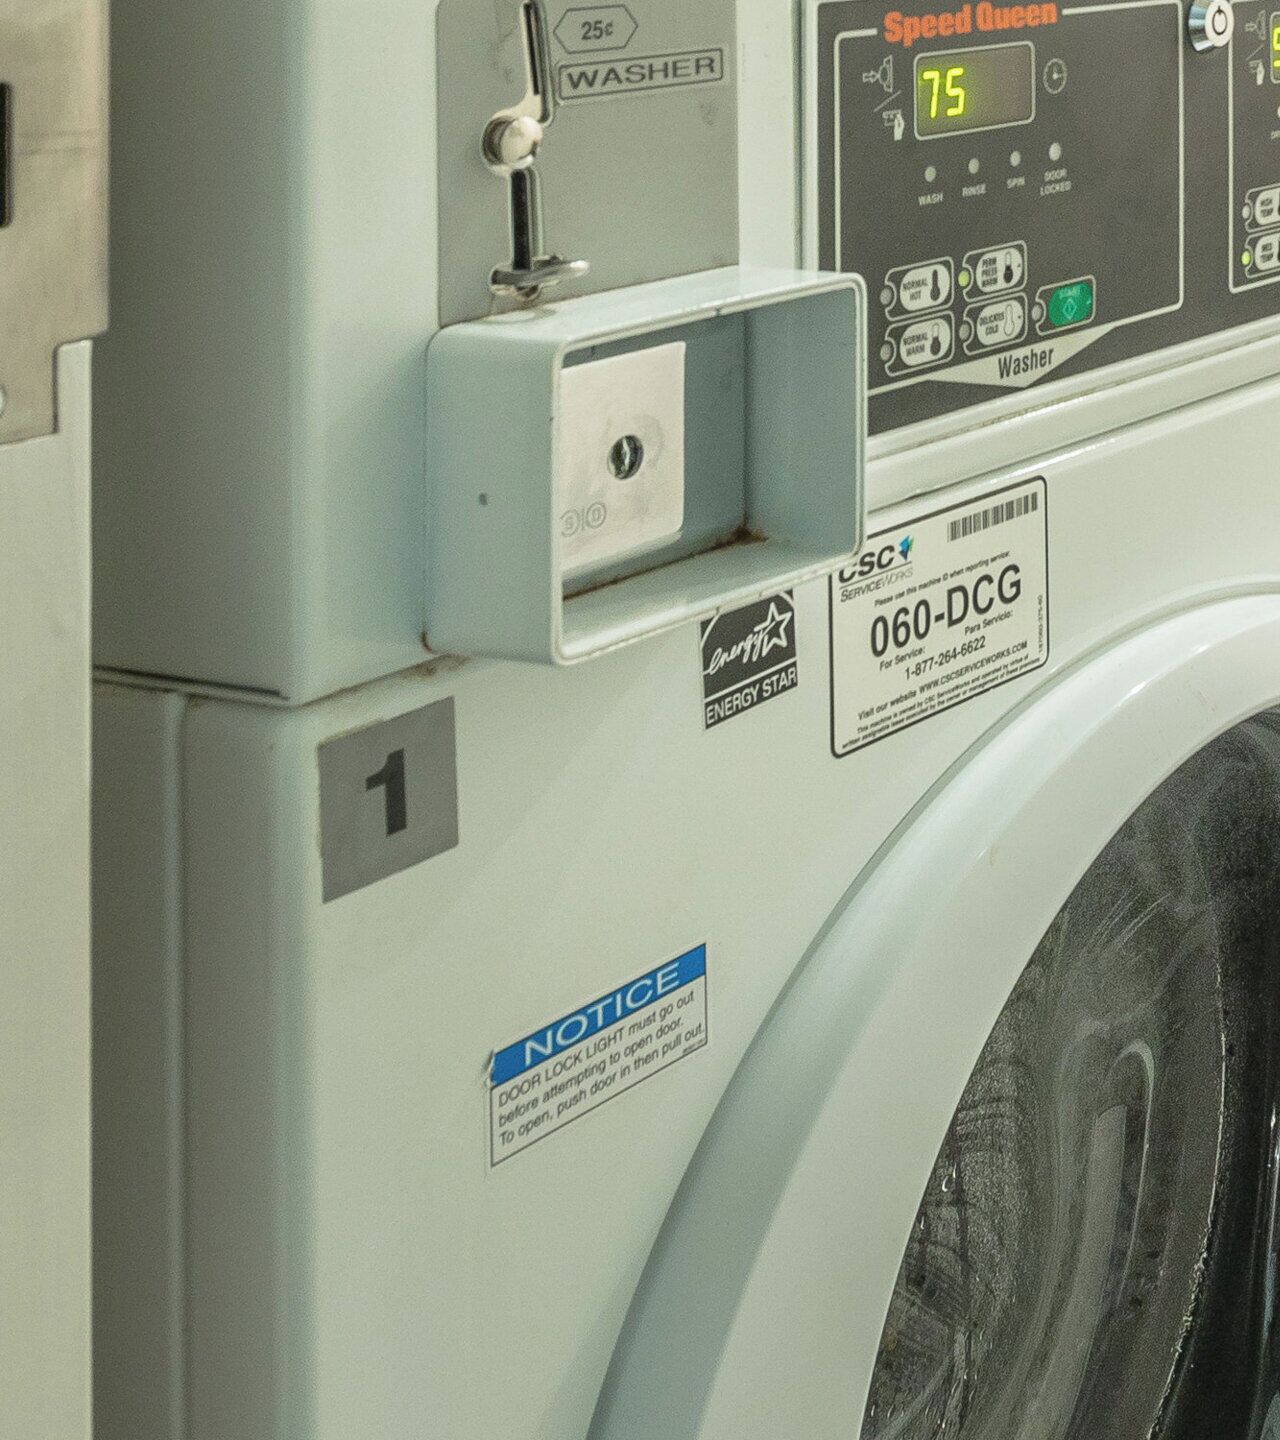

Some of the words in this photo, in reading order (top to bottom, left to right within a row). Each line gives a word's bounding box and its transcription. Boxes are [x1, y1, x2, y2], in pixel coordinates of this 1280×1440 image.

[580, 19, 615, 41] 25¢
[883, 3, 972, 48] Speed
[976, 0, 1059, 34] Queen
[567, 56, 716, 91] WASHER
[921, 65, 968, 119] 75
[918, 193, 943, 206] WASH
[962, 183, 987, 197] RINSE
[1006, 176, 1026, 189] SPIN
[997, 345, 1055, 379] Washer
[838, 544, 895, 584] CSC
[870, 563, 1022, 658] 060-DCG
[905, 636, 986, 680] 1-877-264-6622
[706, 686, 760, 725] ENERGY
[762, 667, 797, 698] STAR
[365, 748, 408, 837] 1
[525, 961, 680, 1066] NOTICE
[498, 1072, 541, 1109] DOOR
[544, 1050, 582, 1084] LOCK
[585, 1029, 623, 1061] LIGHT
[627, 1011, 656, 1038] must
[658, 1004, 673, 1023] go
[676, 991, 694, 1011] out
